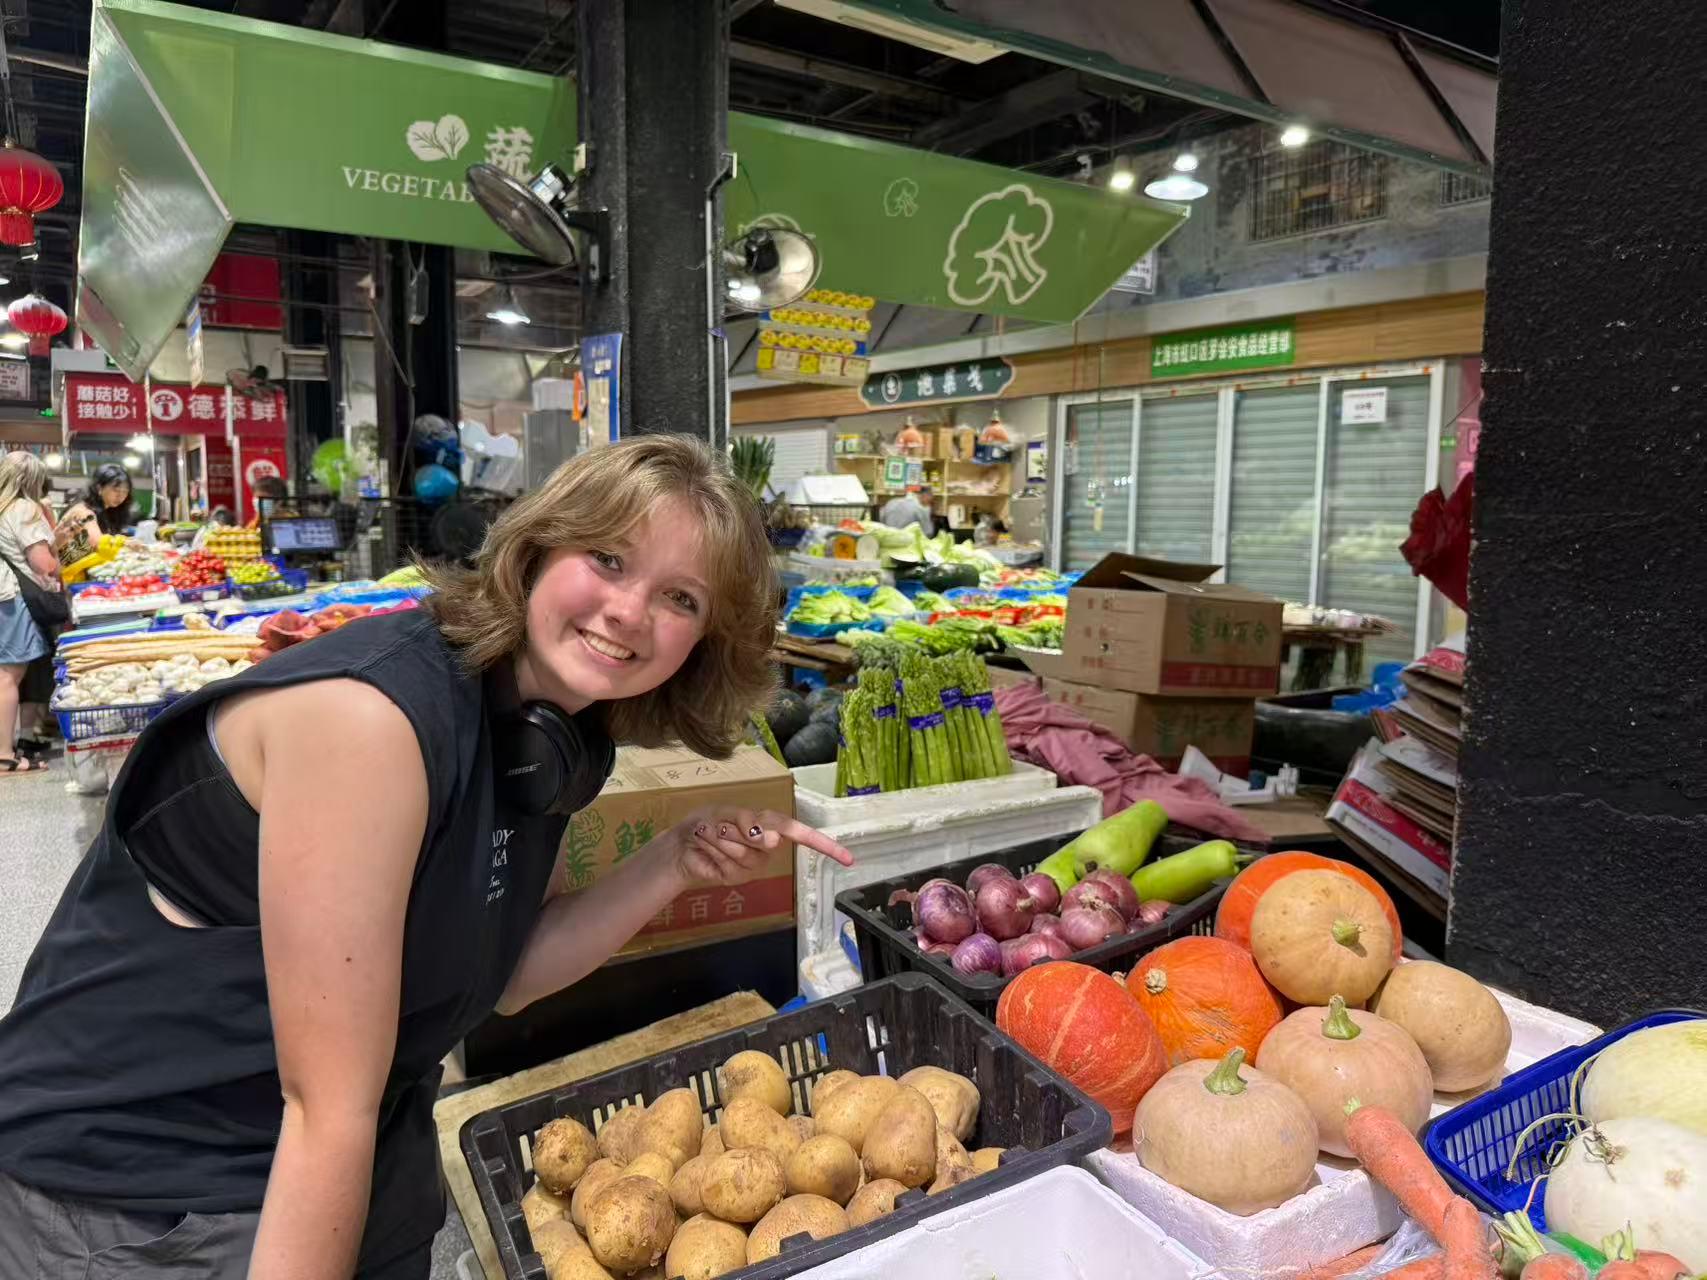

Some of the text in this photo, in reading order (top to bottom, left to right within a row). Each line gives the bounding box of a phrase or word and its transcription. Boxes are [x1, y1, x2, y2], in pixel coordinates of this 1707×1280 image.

[484, 127, 534, 186] 蔬
[188, 394, 287, 421] 德添鲜
[492, 848, 507, 868] GA
